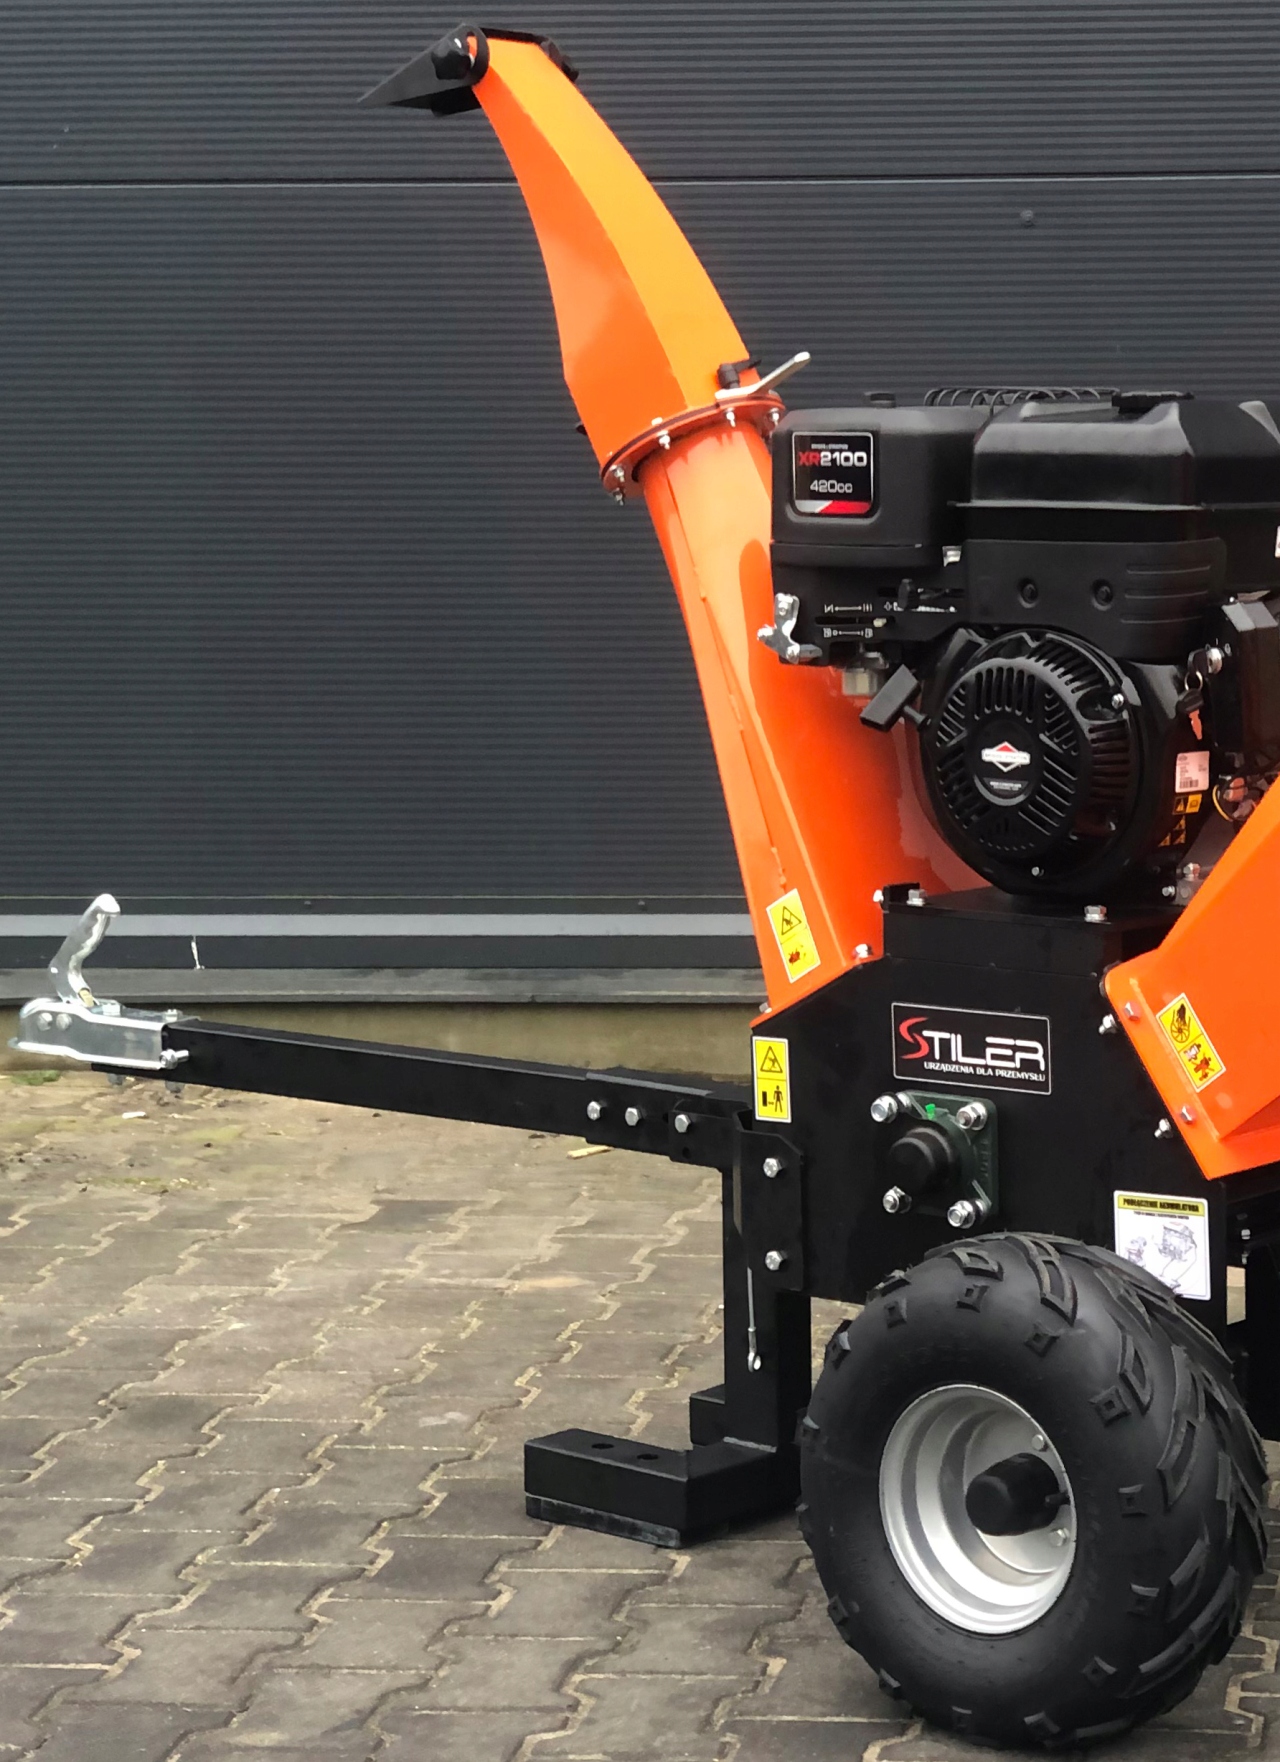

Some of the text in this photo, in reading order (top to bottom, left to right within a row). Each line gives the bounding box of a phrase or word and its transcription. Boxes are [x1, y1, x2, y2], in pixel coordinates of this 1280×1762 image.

[798, 451, 867, 467] XR2100
[898, 1016, 1045, 1072] STILER
[923, 1061, 1045, 1082] URZĄDZENIA DLA PRZEMYSŁU
